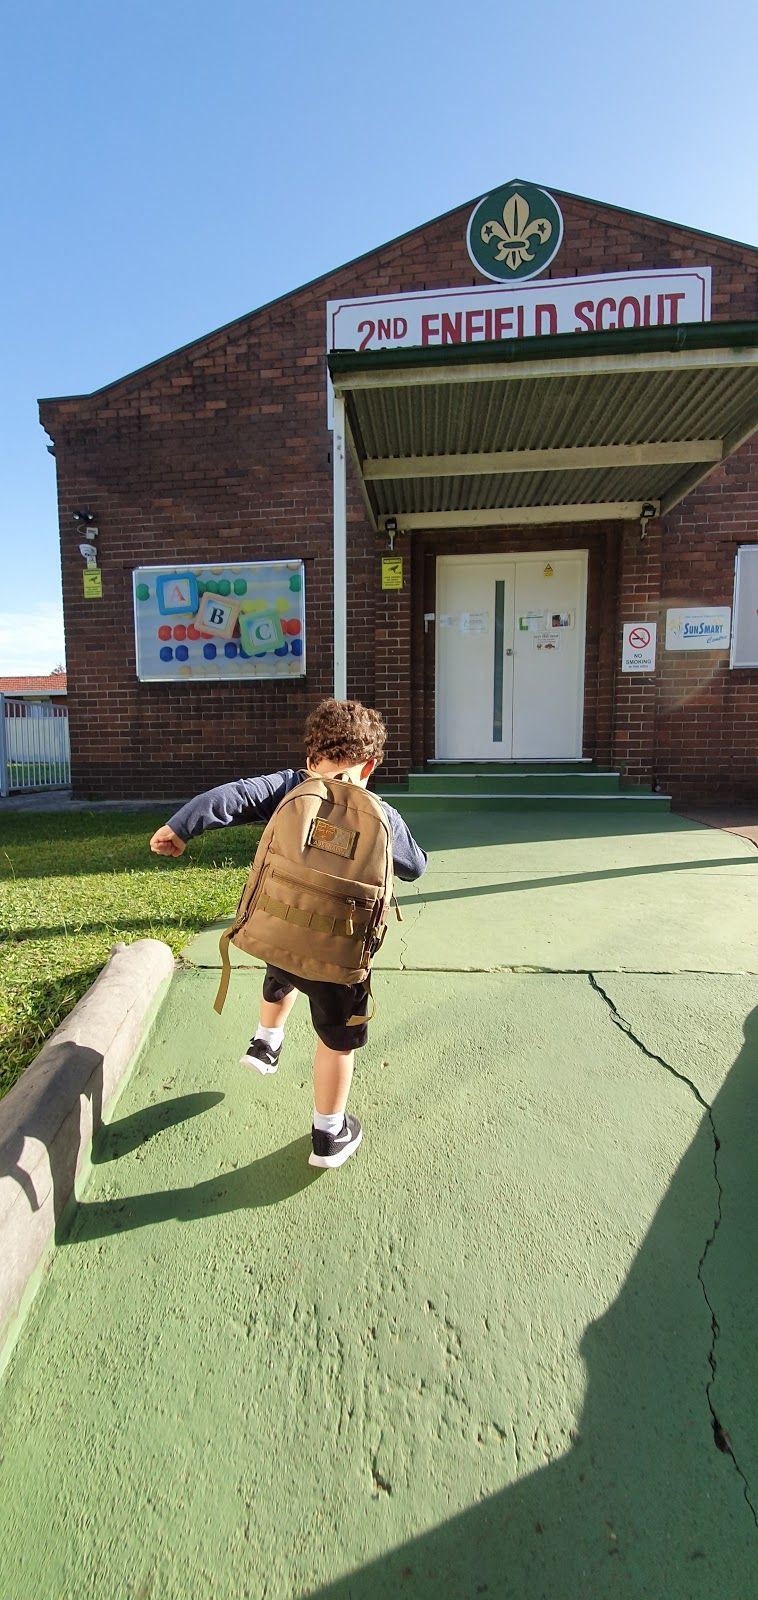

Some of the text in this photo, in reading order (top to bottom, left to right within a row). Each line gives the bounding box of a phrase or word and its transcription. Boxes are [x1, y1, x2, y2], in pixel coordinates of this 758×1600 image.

[357, 292, 686, 352] 2ND ENFIELD SCOUT
[167, 585, 272, 641] A B C
